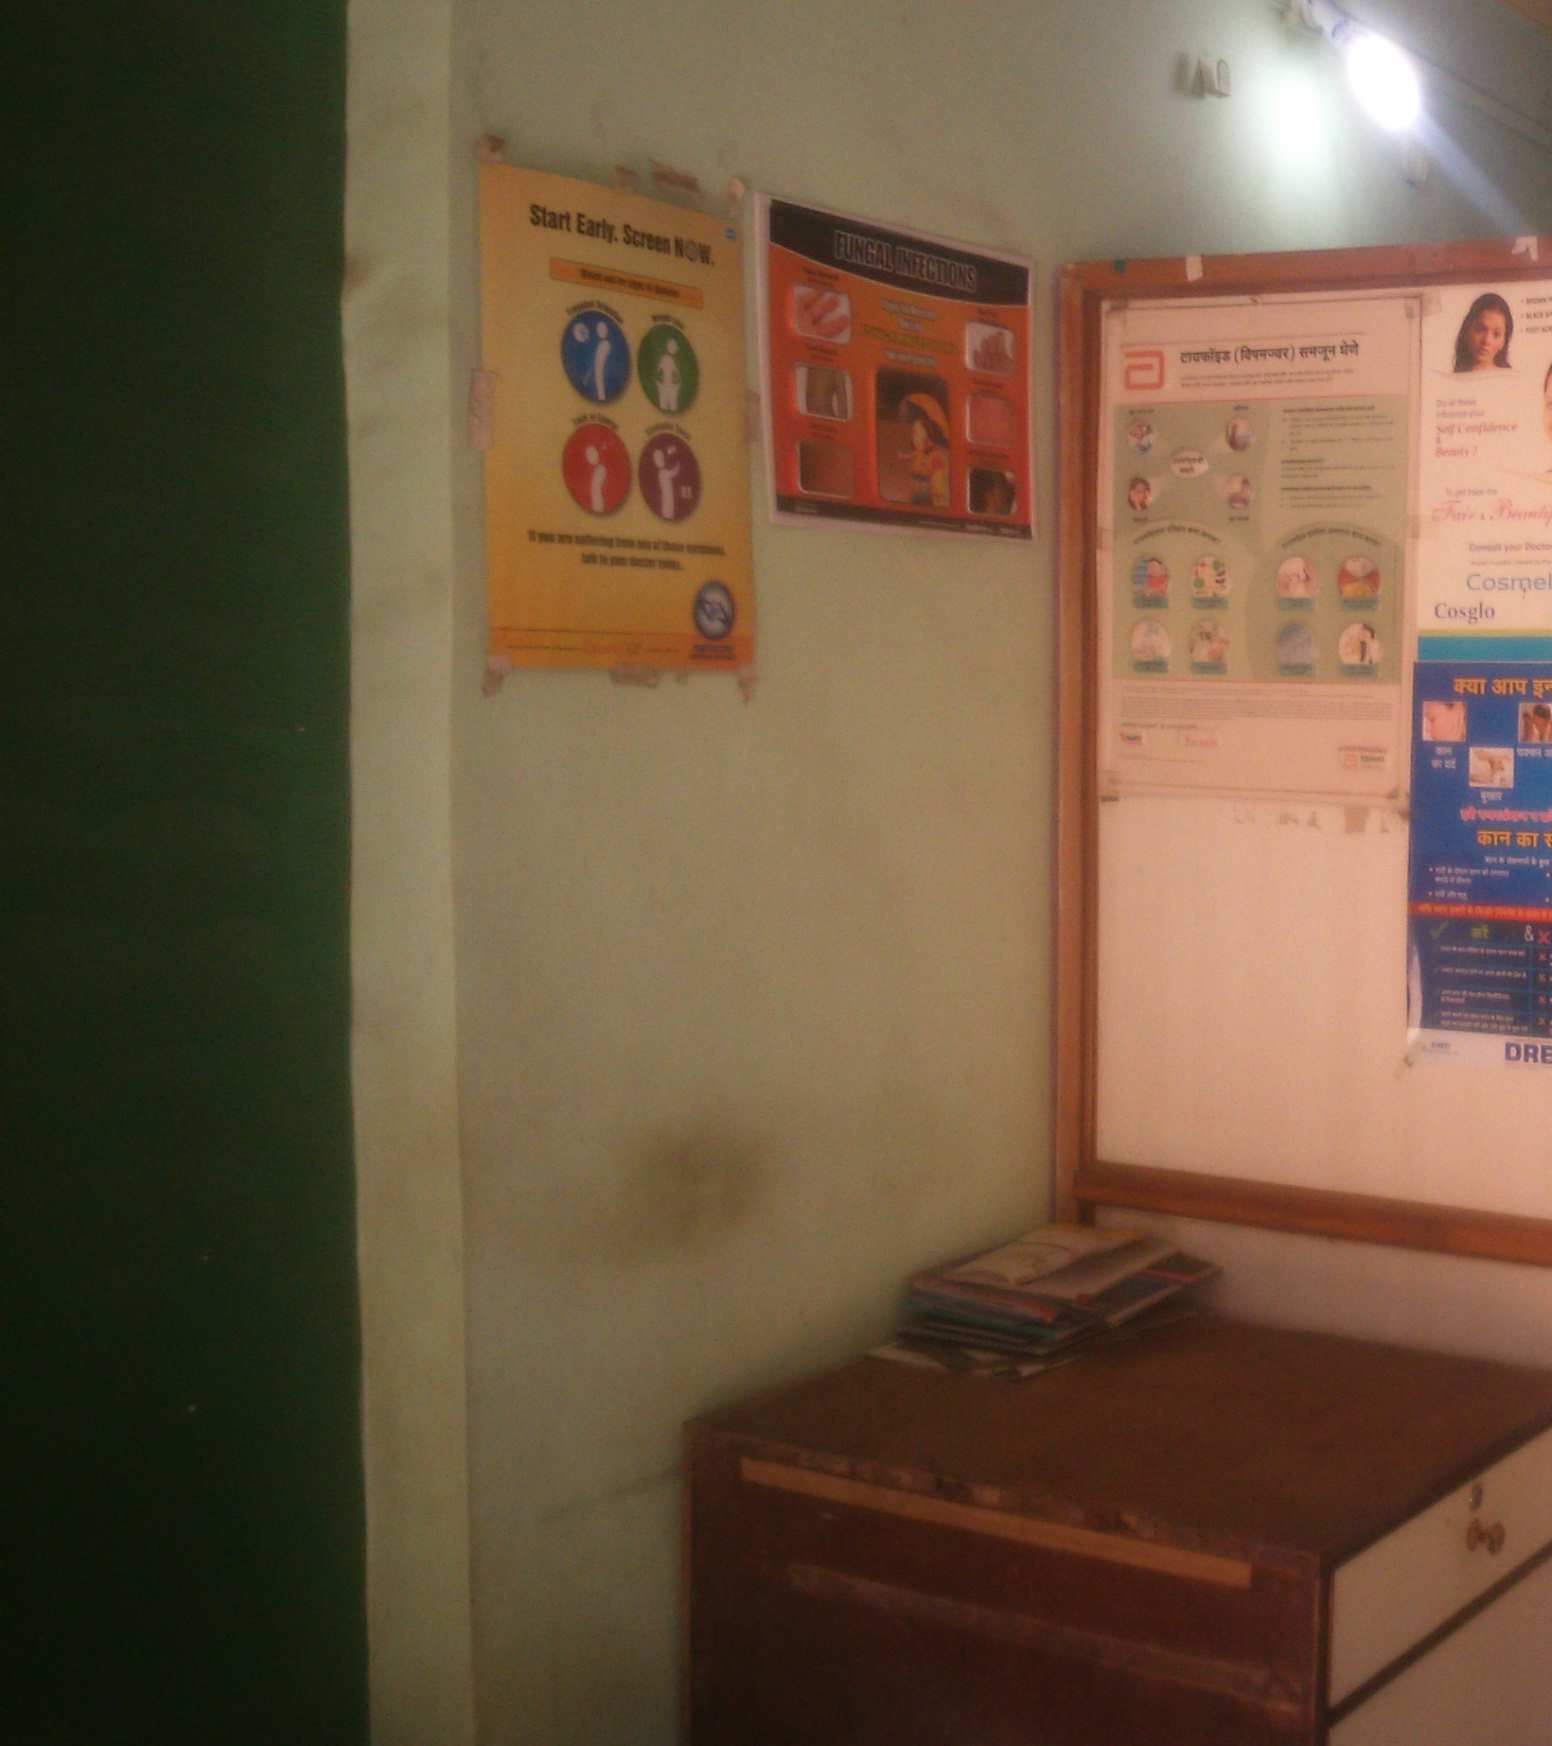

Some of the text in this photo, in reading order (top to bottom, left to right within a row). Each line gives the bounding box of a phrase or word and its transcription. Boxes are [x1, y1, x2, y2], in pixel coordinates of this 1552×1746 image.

[530, 203, 571, 232] Start
[576, 212, 618, 244] Early.
[623, 224, 672, 255] Screen
[833, 229, 894, 273] FUNGAL
[894, 246, 978, 294] INFECTIONS
[1434, 601, 1496, 624] Cosglo
[1454, 677, 1486, 696] क्या
[1492, 677, 1528, 696] आप
[1477, 829, 1511, 847] कान
[1516, 830, 1539, 848] का
[1524, 923, 1535, 943] &
